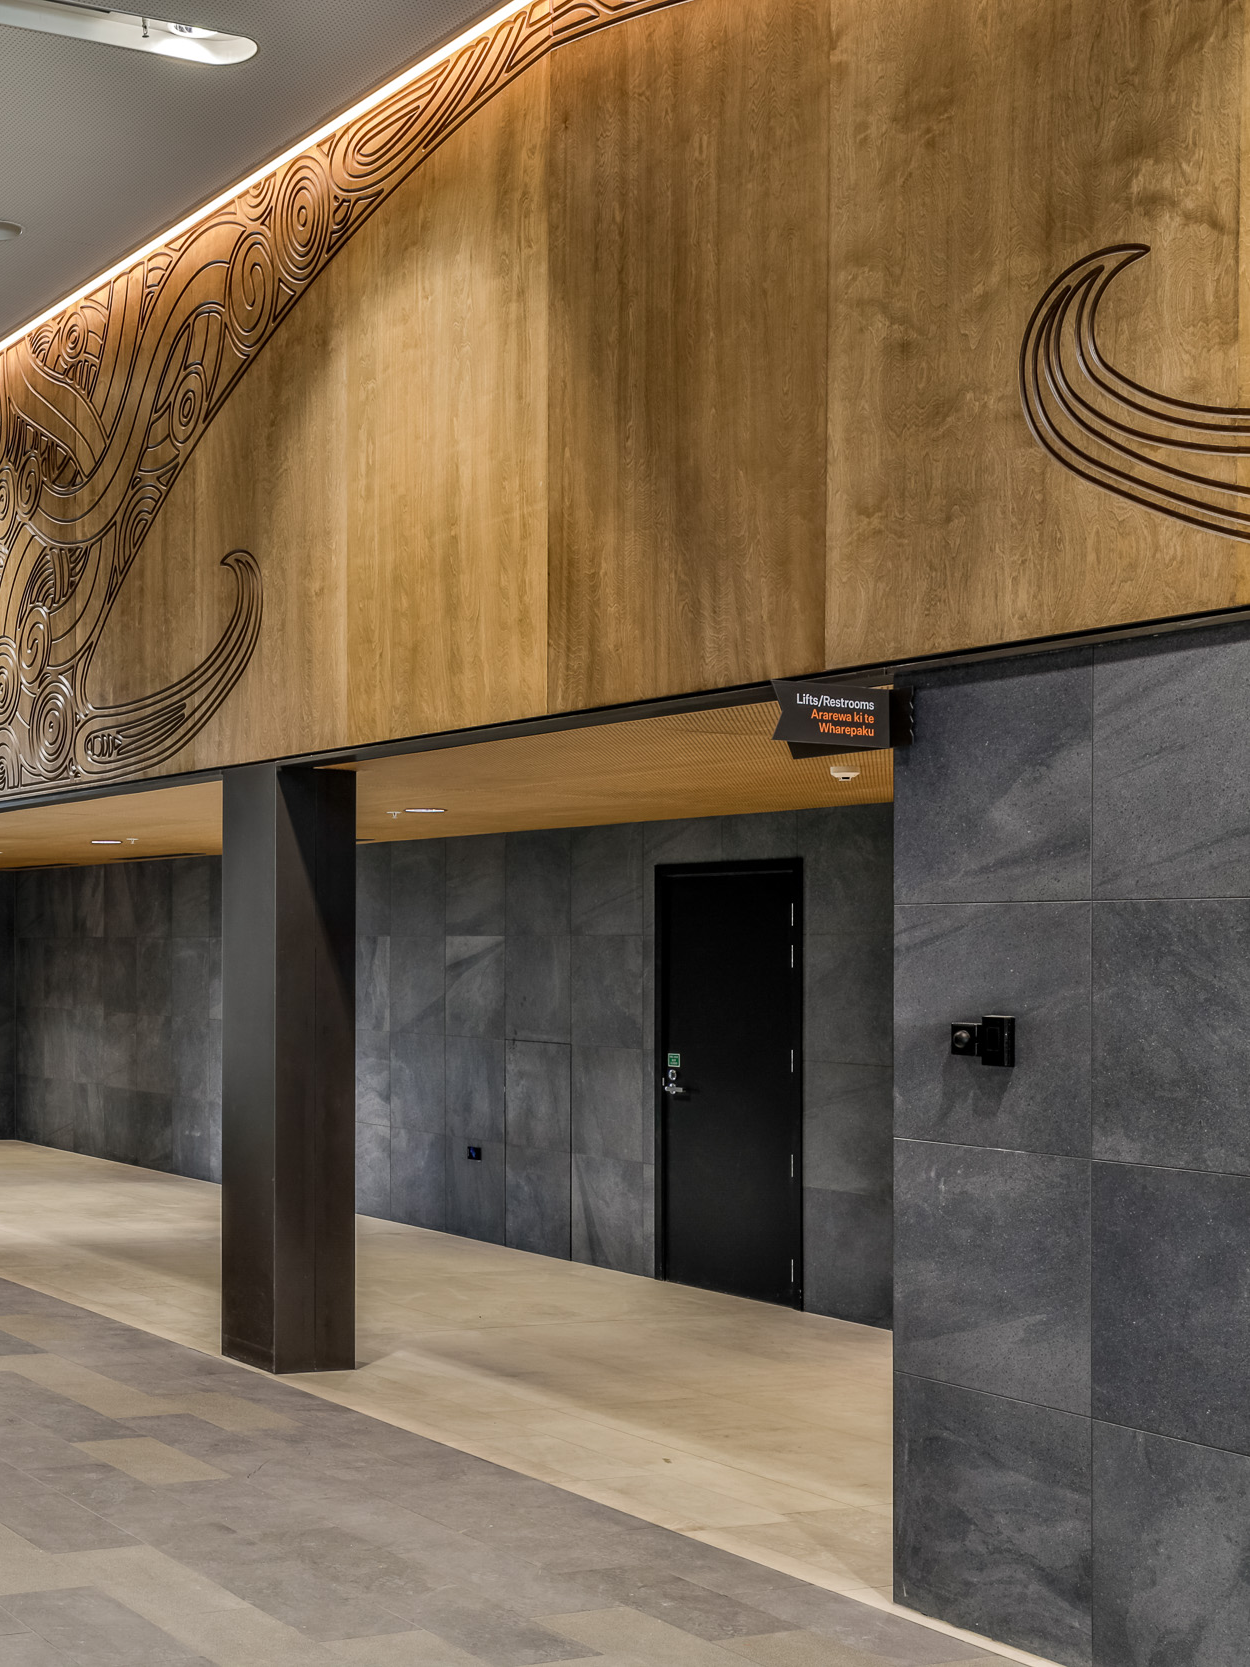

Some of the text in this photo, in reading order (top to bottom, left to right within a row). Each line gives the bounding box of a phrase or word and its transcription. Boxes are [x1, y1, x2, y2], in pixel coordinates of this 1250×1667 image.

[796, 693, 875, 710] Lifts/Restrooms
[811, 709, 875, 723] Ararewa ki te
[818, 722, 875, 737] Wharepaku
